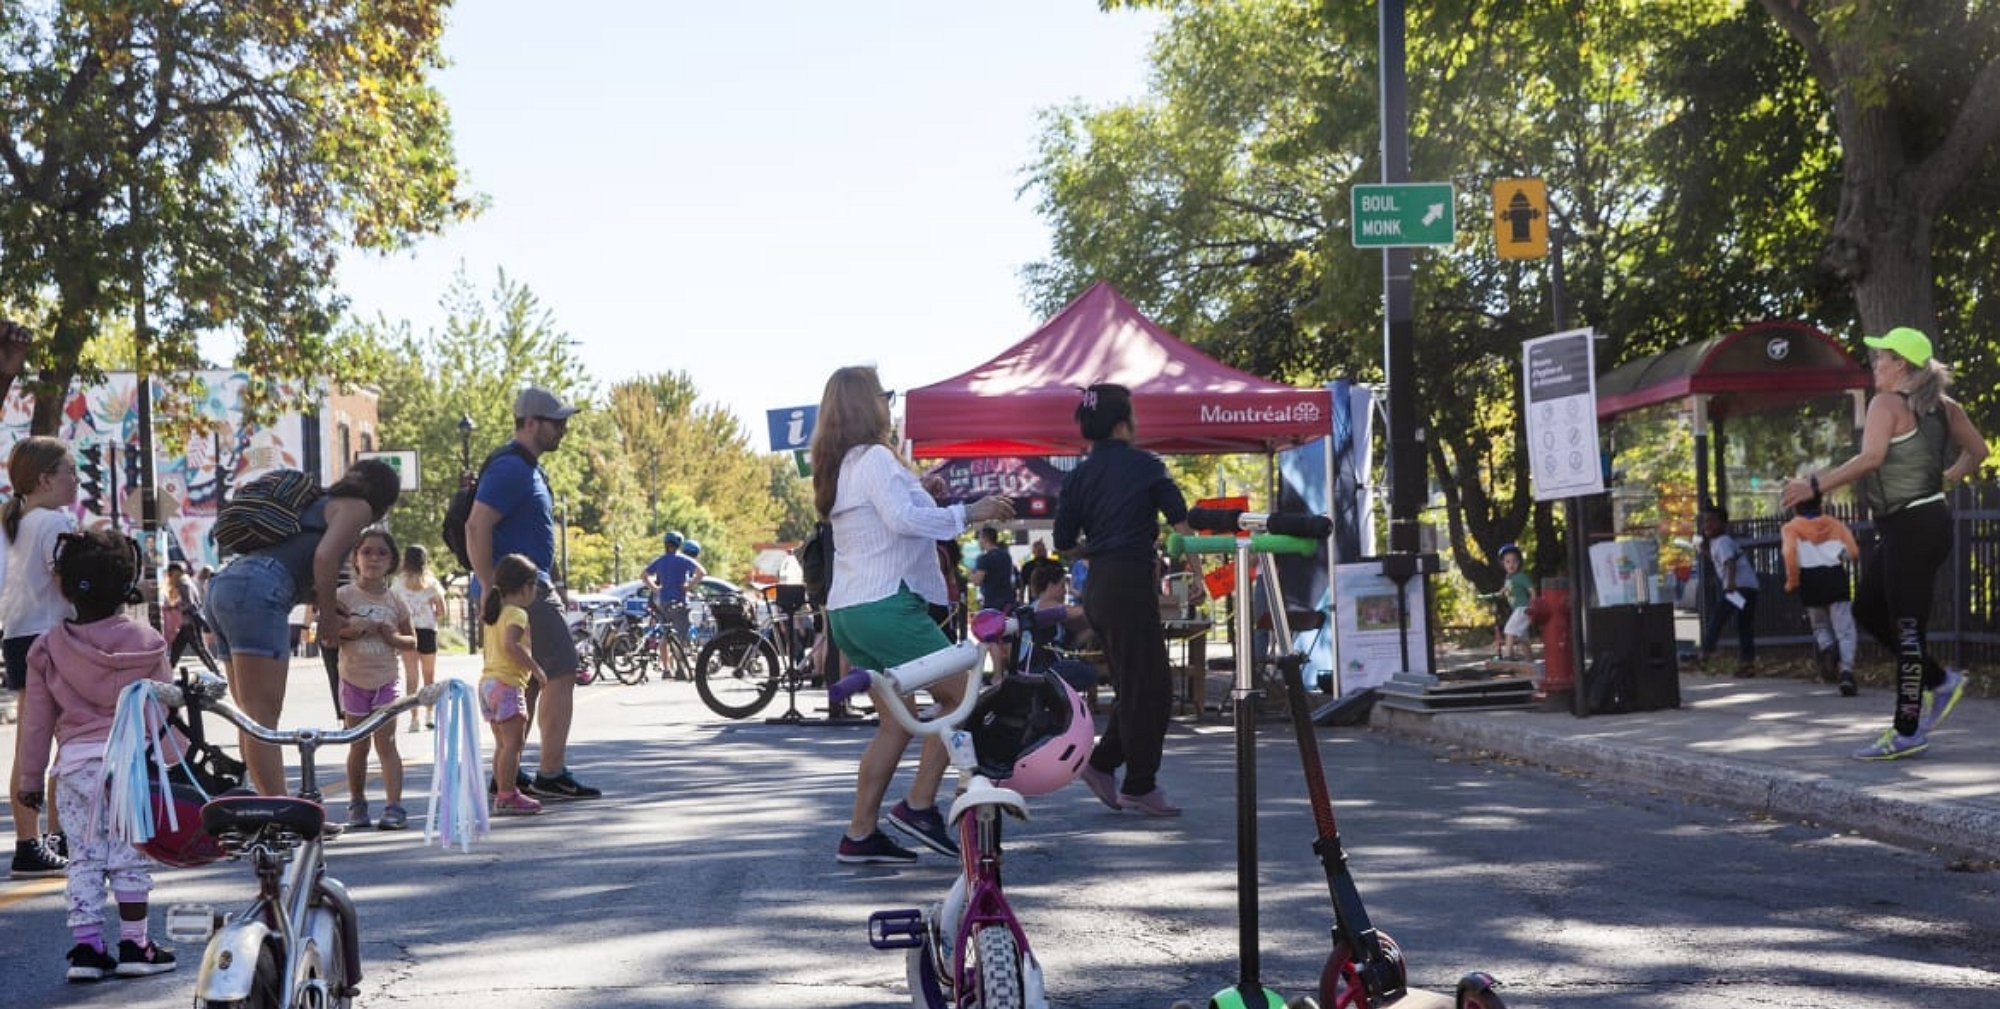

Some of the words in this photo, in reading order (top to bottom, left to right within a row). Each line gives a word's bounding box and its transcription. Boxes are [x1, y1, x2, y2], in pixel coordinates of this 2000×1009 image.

[1362, 218, 1402, 236] MONK
[1201, 404, 1291, 422] Montréal
[969, 472, 1041, 493] JEUX
[1901, 662, 1922, 701] STOP
